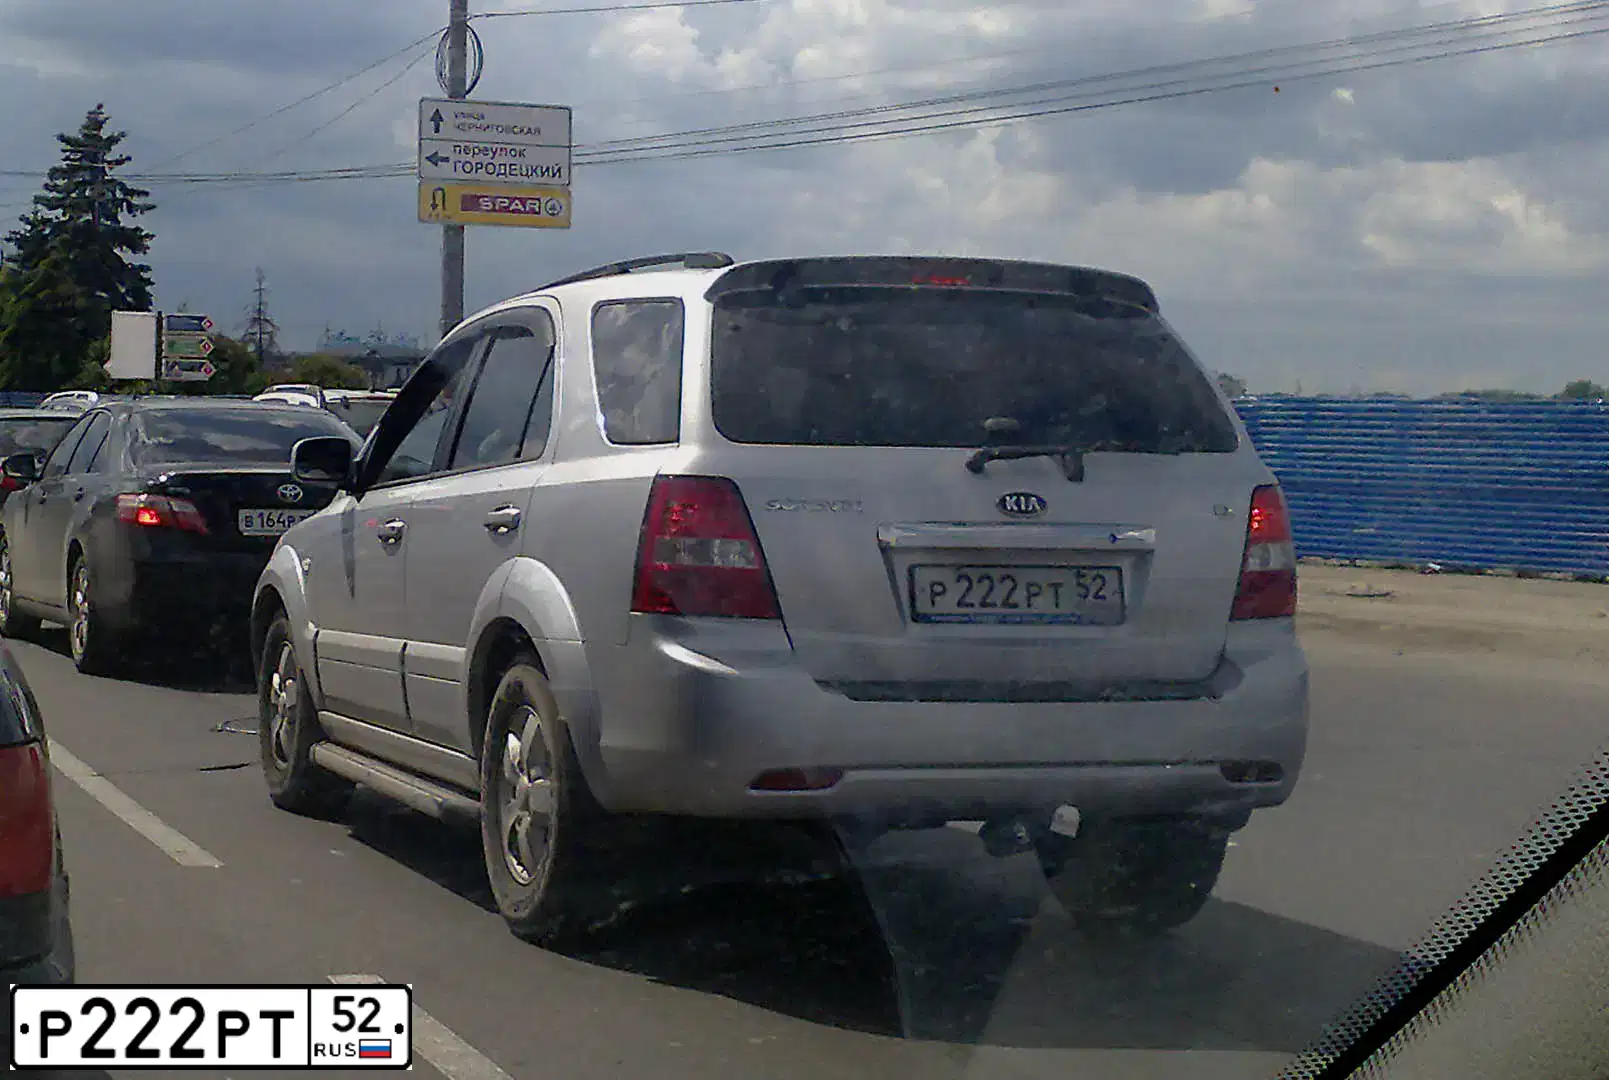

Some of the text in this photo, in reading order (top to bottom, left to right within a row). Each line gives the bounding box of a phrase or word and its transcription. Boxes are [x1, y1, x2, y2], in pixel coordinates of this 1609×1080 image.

[453, 145, 526, 160] переулок
[453, 161, 562, 179] ГОРОДЕЦКИЙ
[479, 197, 540, 213] SPAR
[1005, 495, 1041, 510] KIA
[1074, 569, 1107, 600] 52
